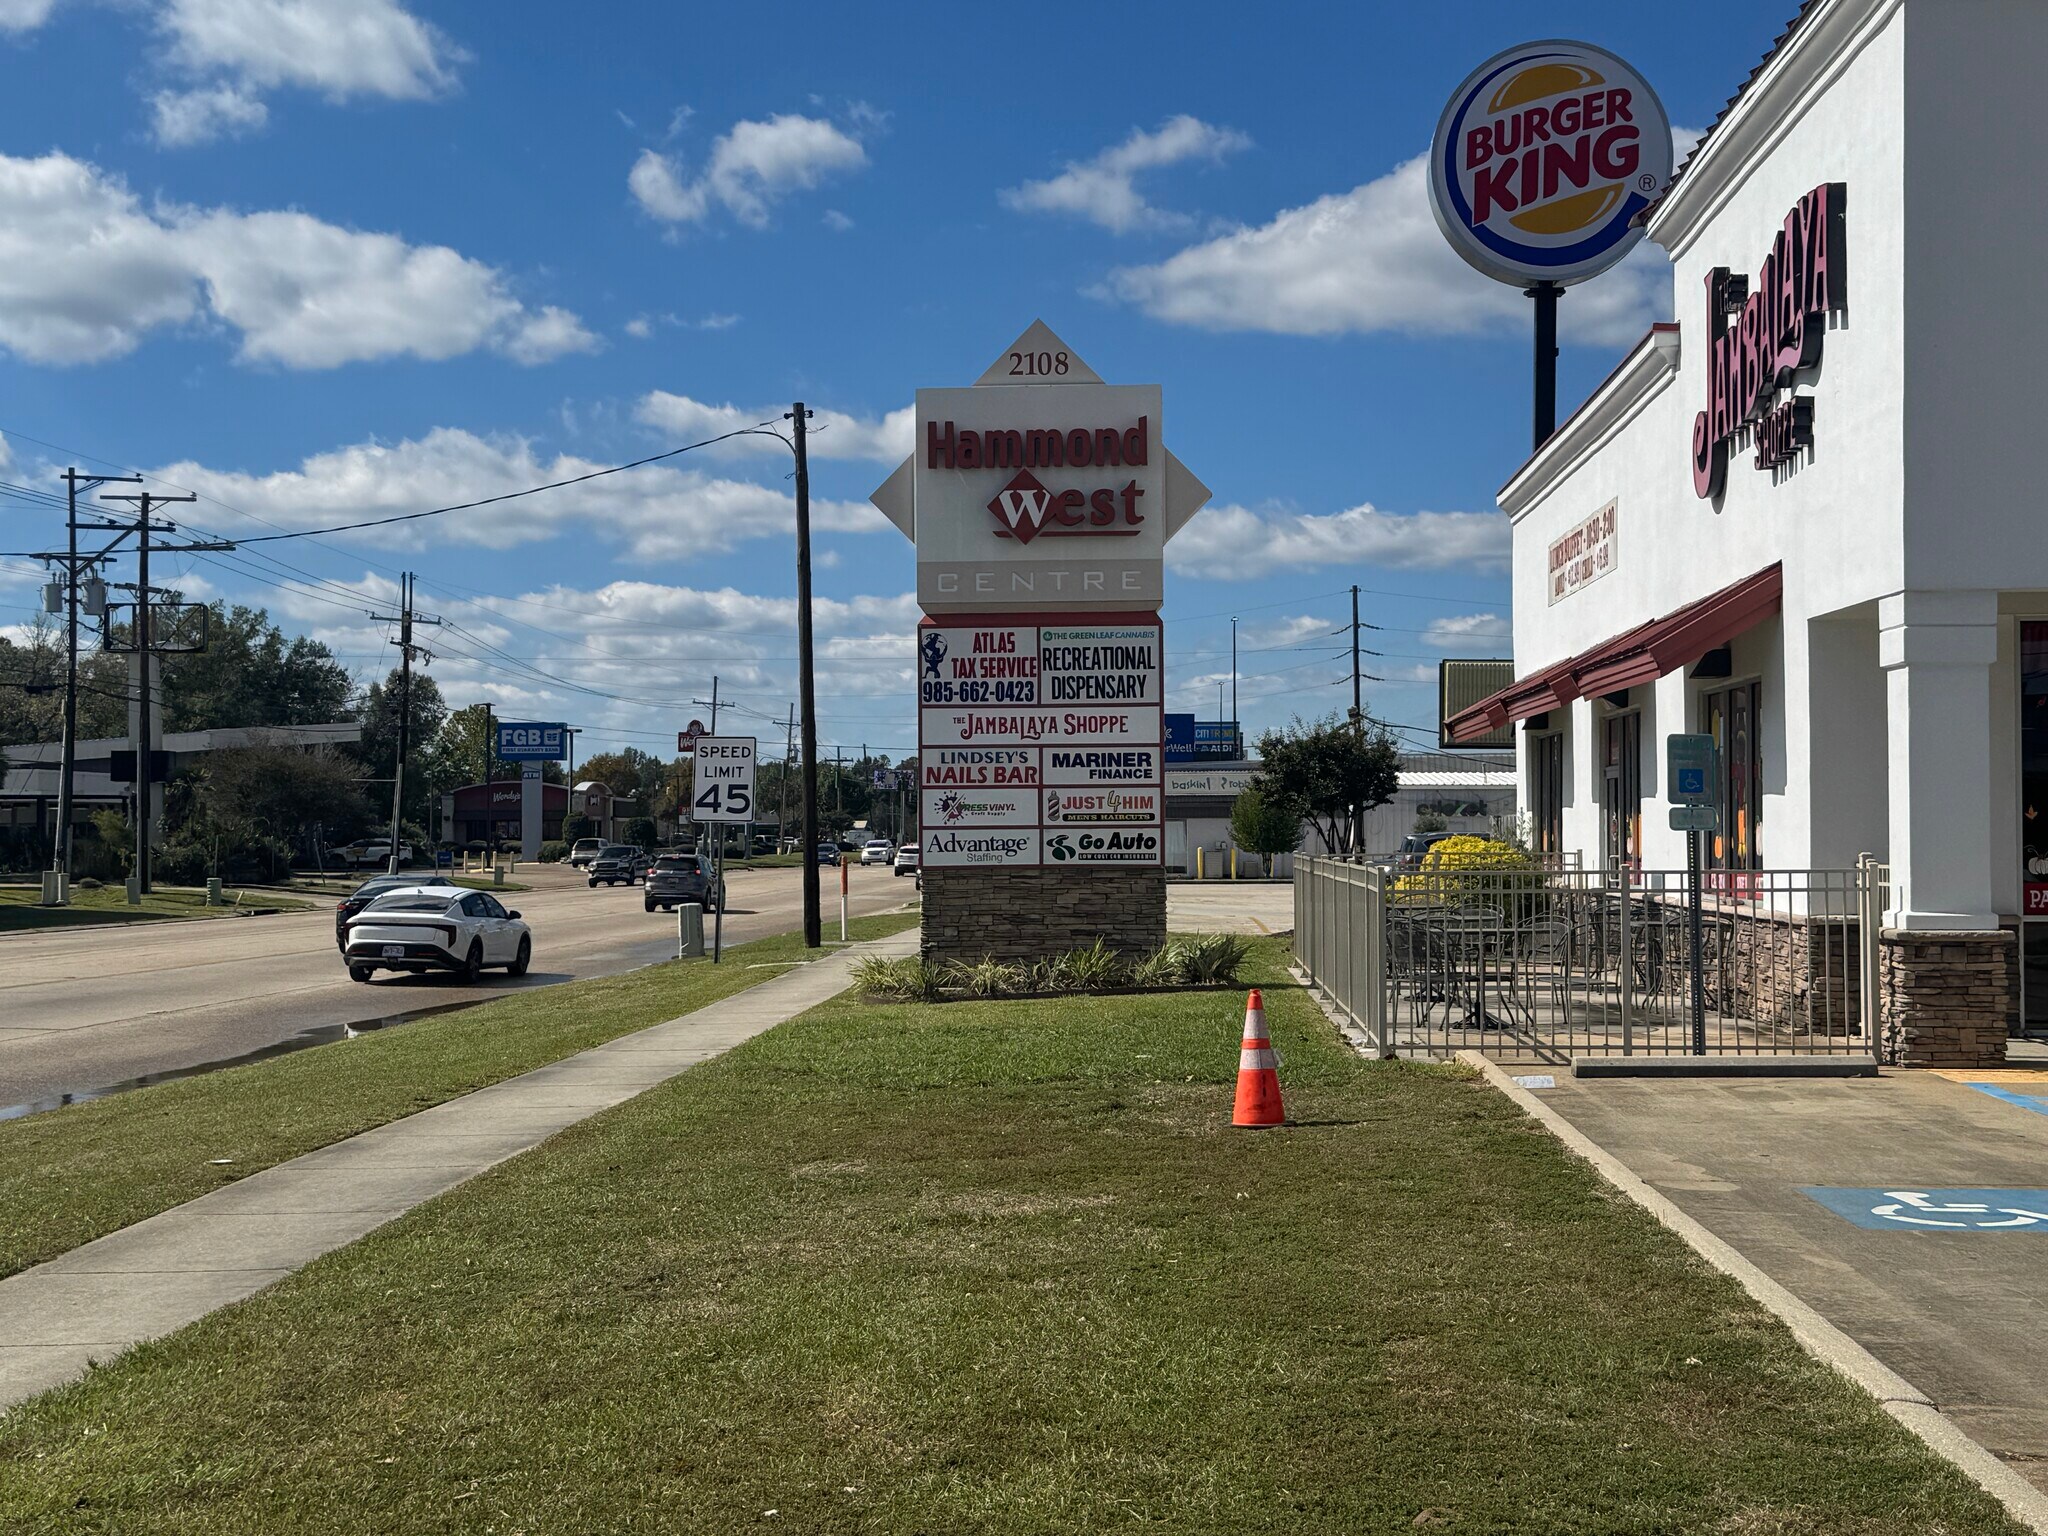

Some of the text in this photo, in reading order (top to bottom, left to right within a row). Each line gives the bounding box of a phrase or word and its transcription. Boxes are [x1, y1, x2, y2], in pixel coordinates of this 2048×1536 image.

[1466, 88, 1633, 170] BURGER
[1473, 124, 1639, 226] KING
[1693, 182, 1846, 499] JAMBALAYA
[1008, 351, 1069, 376] 2108
[927, 414, 1149, 470] Hammond
[998, 479, 1145, 529] West
[937, 571, 1142, 593] CENTRE
[973, 632, 1015, 654] ATLAS
[1053, 632, 1067, 640] THE
[1114, 631, 1155, 639] CANNABIS
[951, 656, 1037, 679] TAX SERVICE
[1042, 646, 1155, 671] RECREATIONAL
[923, 681, 1034, 703] 985-662-0423
[1051, 674, 1147, 700] DISPENSARY
[501, 729, 541, 746] FGB
[953, 713, 1129, 741] THE JAMBALAYA SHOPPE
[699, 746, 751, 758] SPEED
[940, 751, 1029, 764] LINDSEY'S
[1051, 752, 1152, 768] MARINER
[704, 766, 745, 778] LIMIT
[926, 766, 988, 784] NAILS
[994, 766, 1038, 784] BAR
[1089, 768, 1153, 780] FINANCE
[695, 784, 750, 814] 45
[989, 803, 1016, 811] VINYL
[1061, 790, 1154, 813] JUST 4 HIM
[926, 832, 1027, 857] Advantage
[1078, 831, 1157, 850] Go Auto
[966, 853, 1003, 864] Staffing
